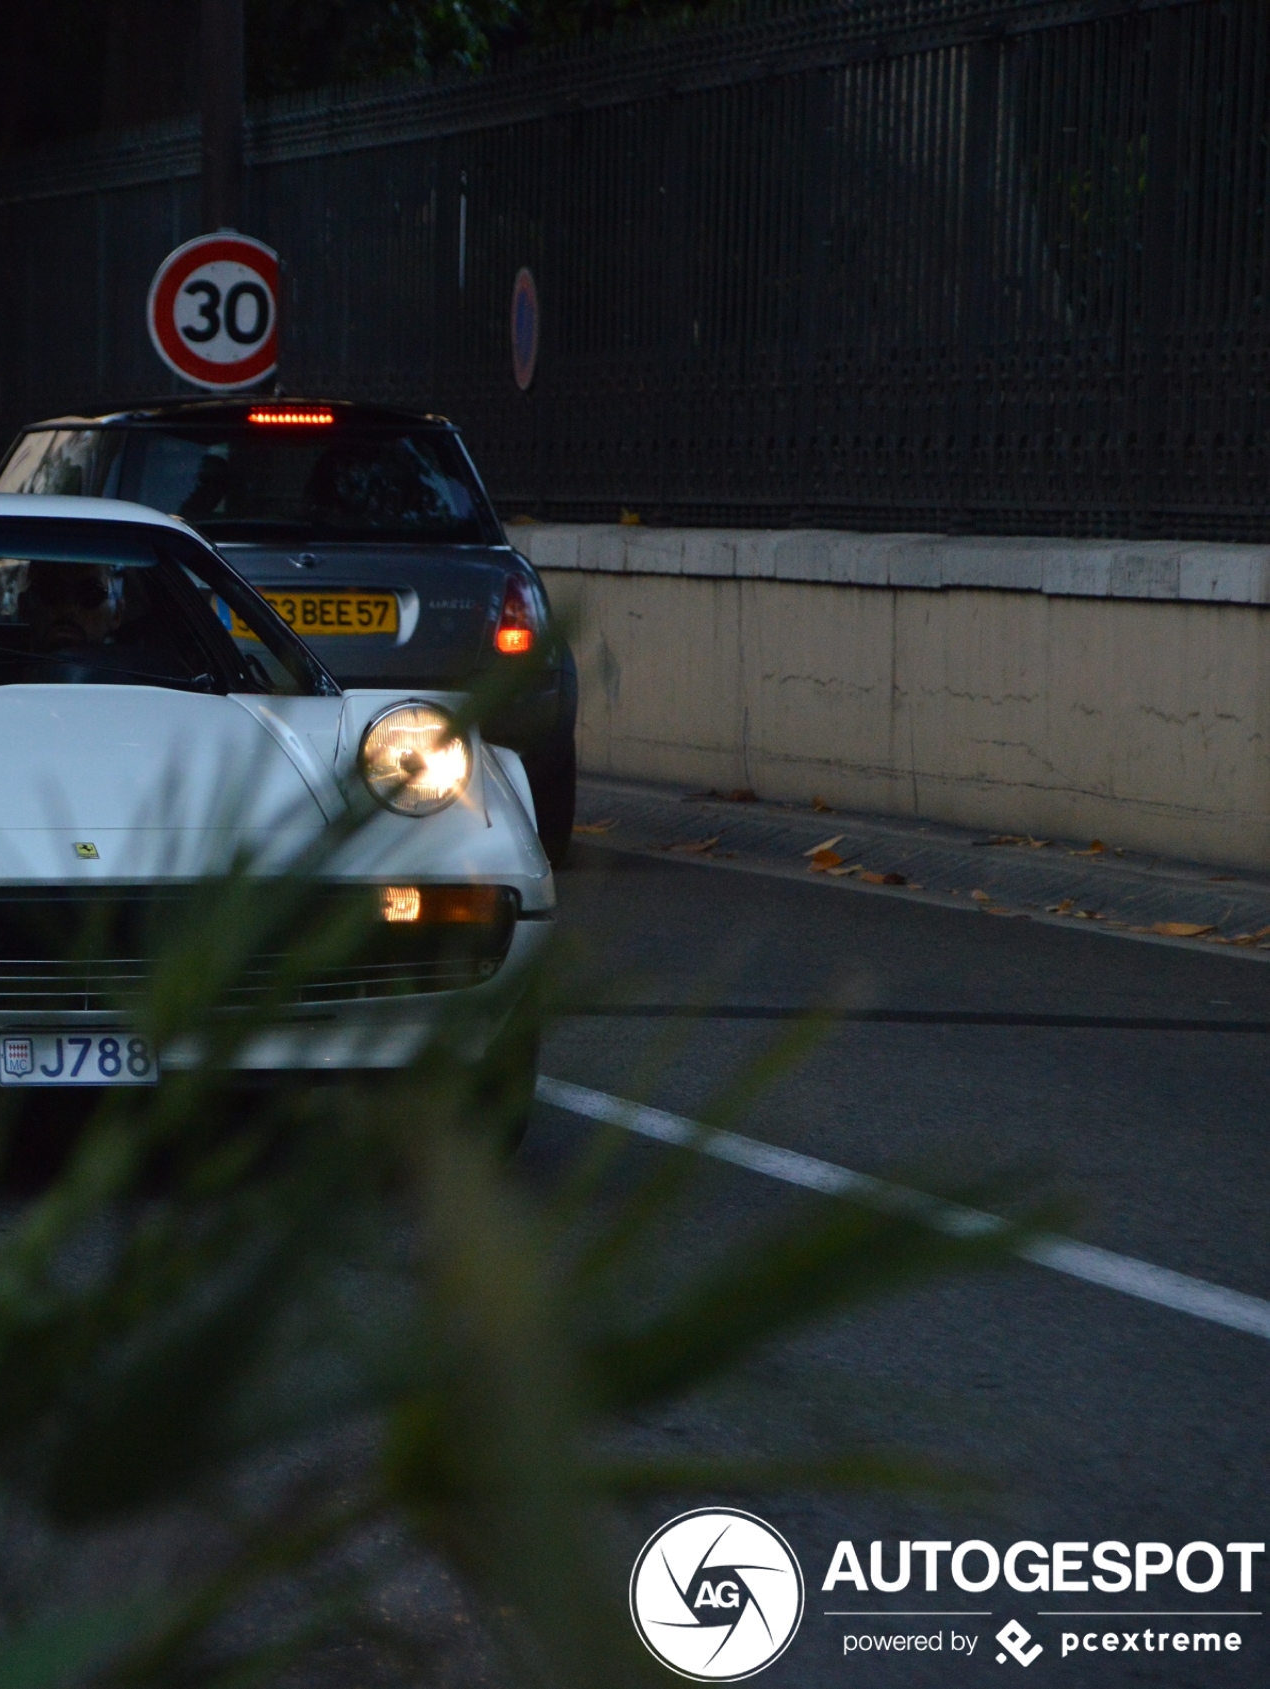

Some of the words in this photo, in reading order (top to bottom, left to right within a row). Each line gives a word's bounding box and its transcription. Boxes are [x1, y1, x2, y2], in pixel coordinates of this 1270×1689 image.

[180, 280, 269, 345] 30
[302, 599, 353, 626] BEE
[356, 600, 390, 627] 57
[9, 1059, 28, 1071] MC
[39, 1037, 152, 1078] J788
